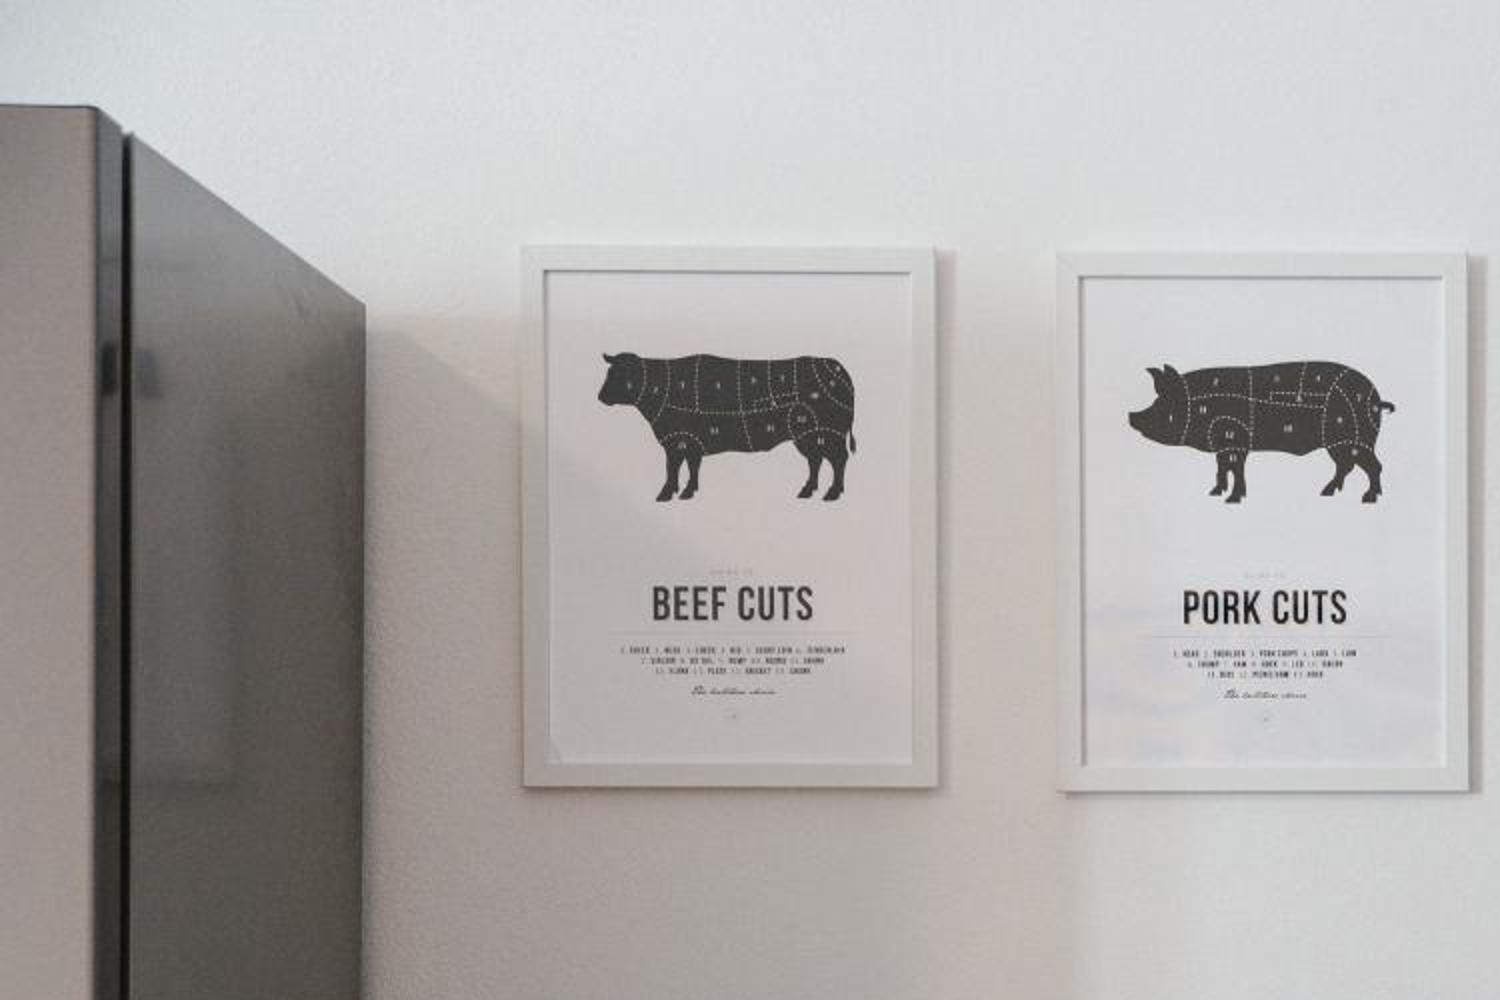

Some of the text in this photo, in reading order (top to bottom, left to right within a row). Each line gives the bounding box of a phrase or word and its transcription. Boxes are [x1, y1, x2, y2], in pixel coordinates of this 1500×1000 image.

[653, 586, 813, 621] BEEF CUTS
[1183, 590, 1347, 625] PORK CUTS
